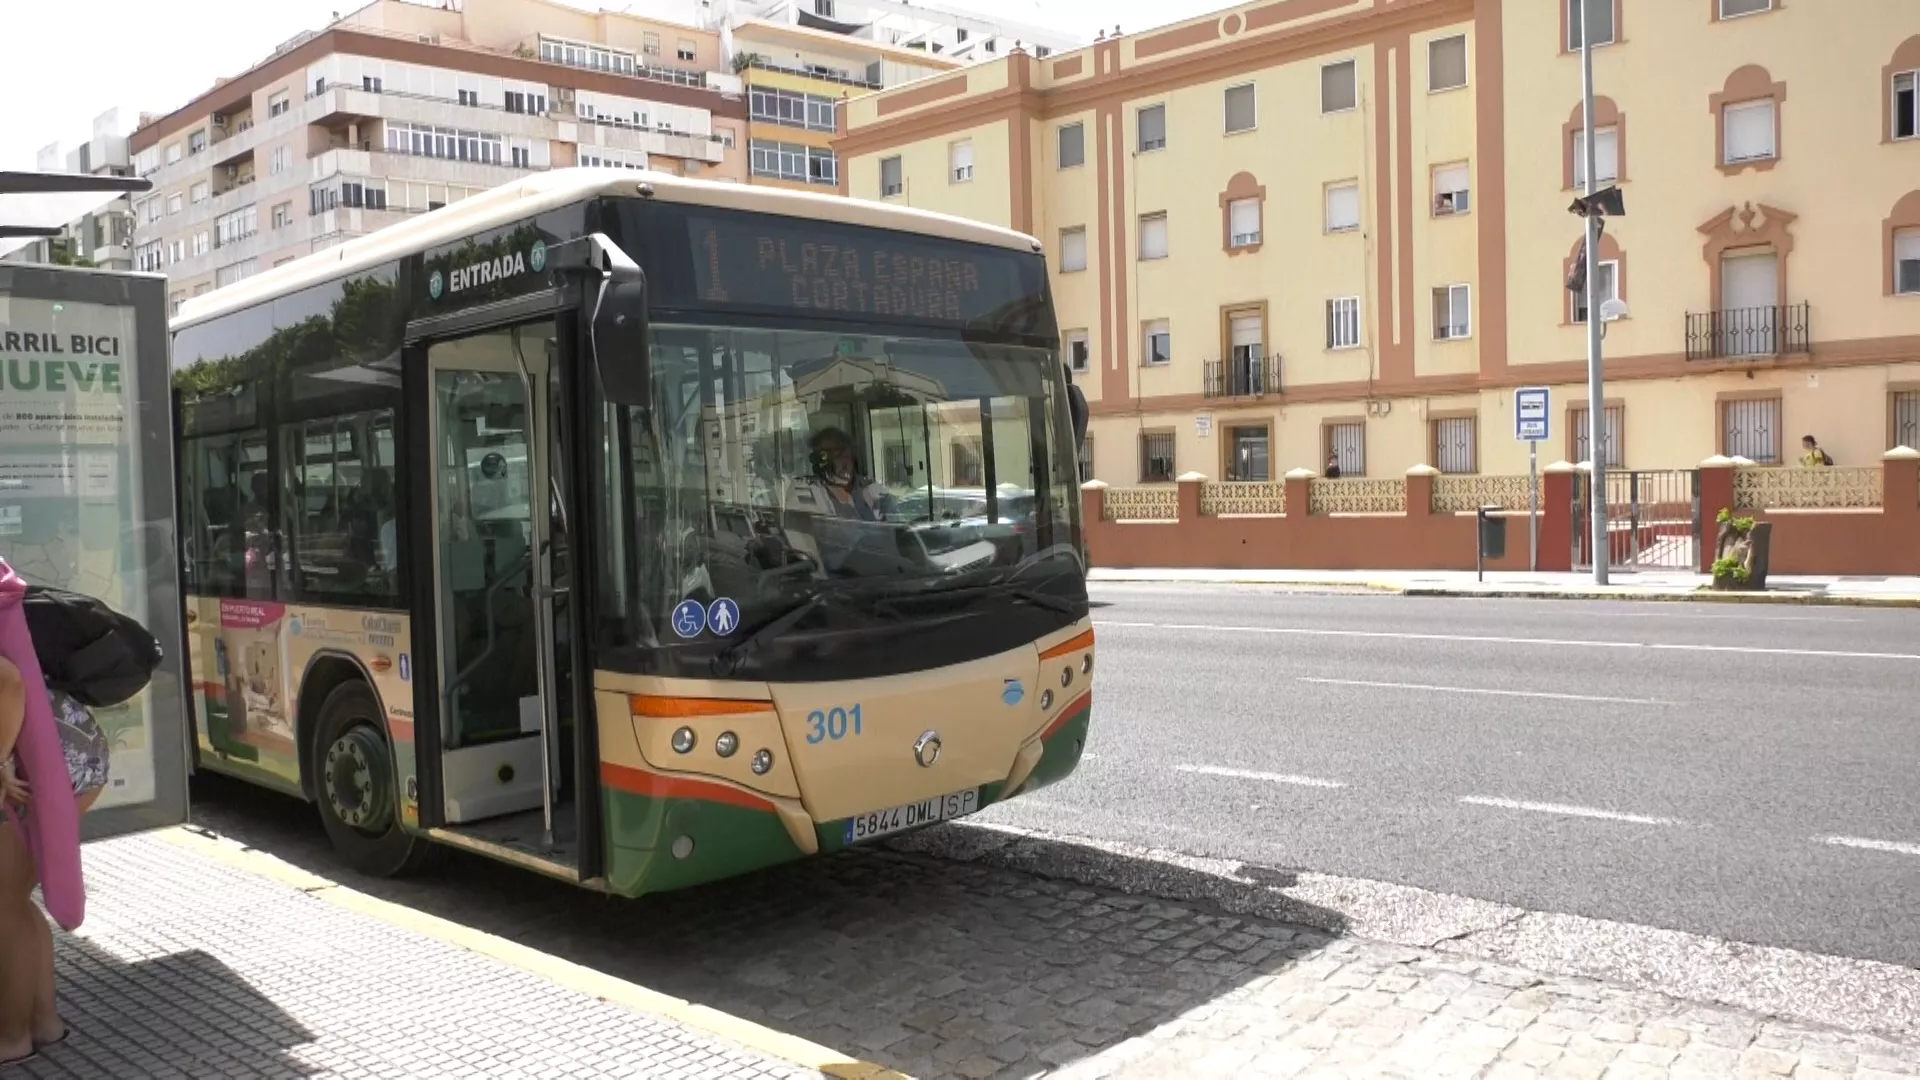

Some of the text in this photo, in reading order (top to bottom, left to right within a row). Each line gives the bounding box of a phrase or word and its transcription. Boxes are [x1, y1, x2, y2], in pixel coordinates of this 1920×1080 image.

[450, 251, 525, 292] ENTRADA
[706, 226, 728, 303] 1
[757, 236, 861, 279] PLAZA
[791, 275, 960, 320] CORTADURA
[0, 331, 119, 356] RRIL BICI
[0, 359, 121, 393] UEVE
[806, 703, 861, 744] 301
[857, 799, 936, 837] 5844 DML
[947, 791, 974, 816] SP
